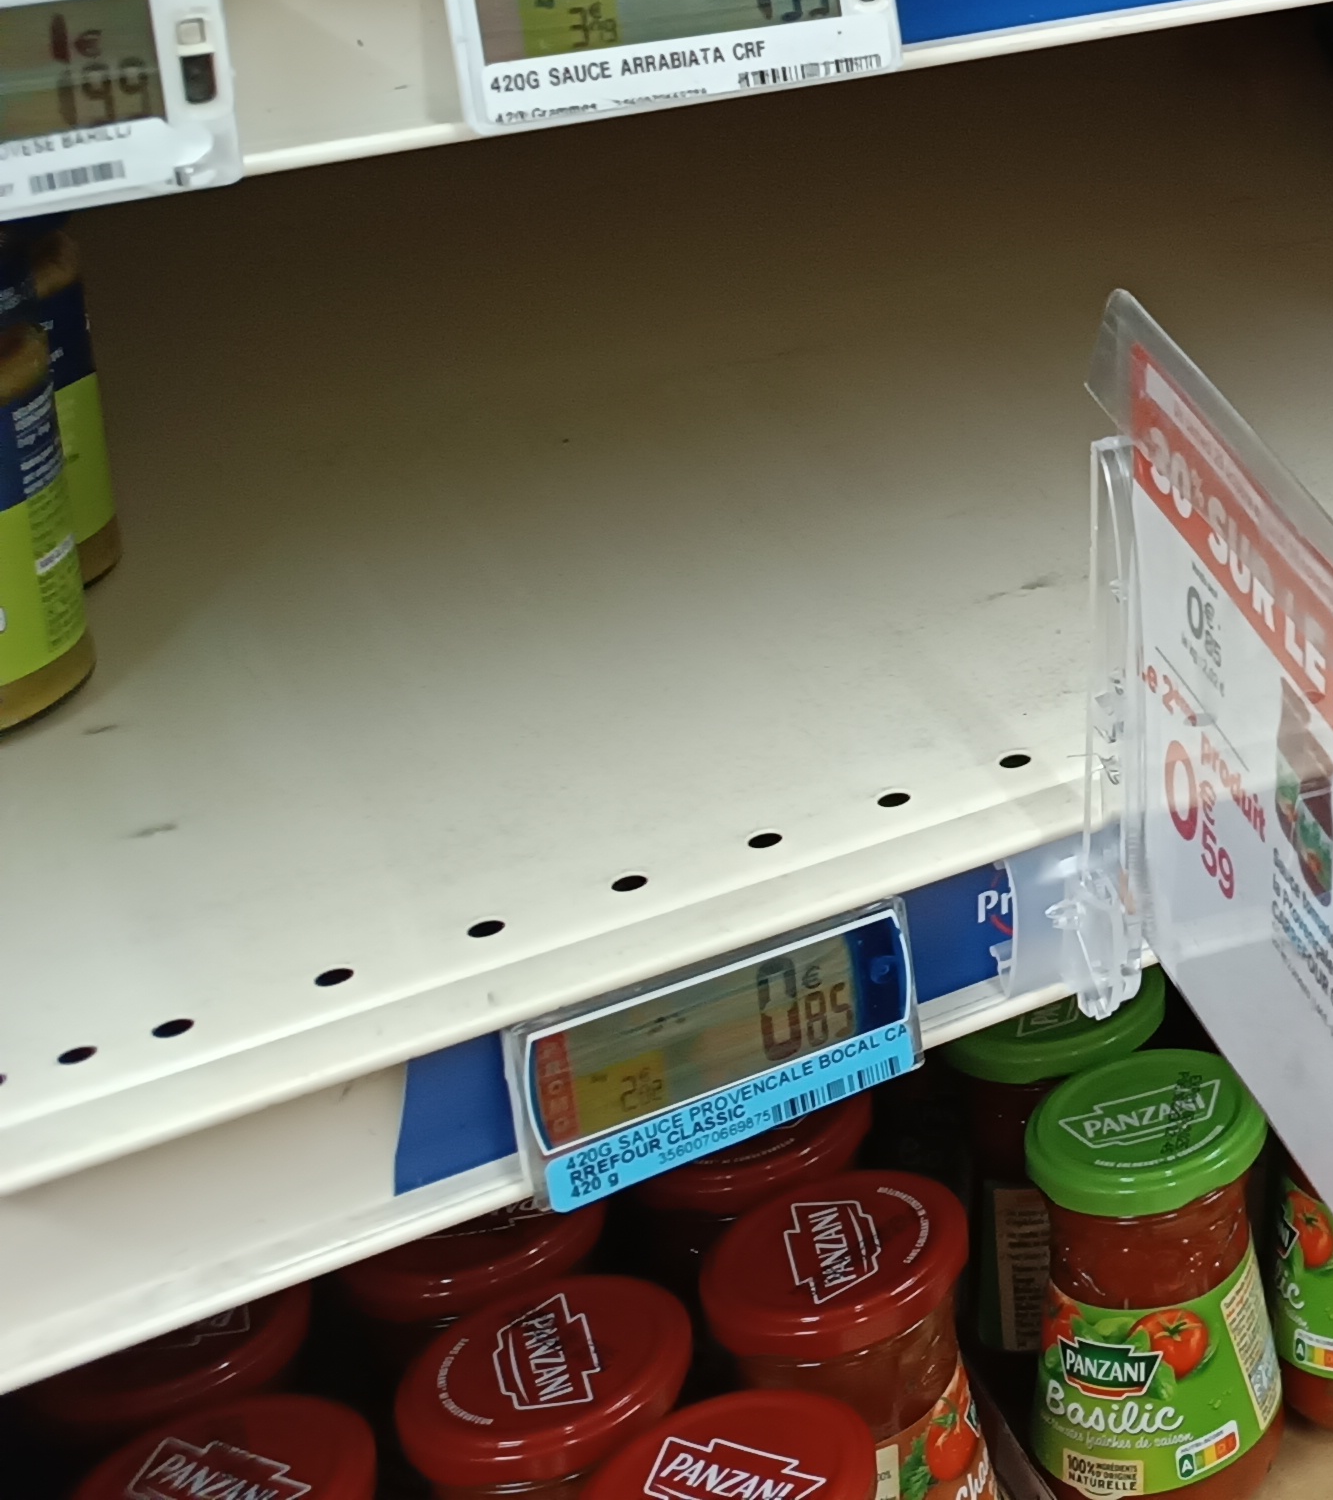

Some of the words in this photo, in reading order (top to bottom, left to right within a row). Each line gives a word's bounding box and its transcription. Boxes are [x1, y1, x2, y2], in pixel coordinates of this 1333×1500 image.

[490, 66, 541, 93] 420G
[549, 59, 612, 88] SAUCE
[620, 46, 726, 77] ARRABIATA
[732, 39, 766, 63] CRF
[566, 1142, 613, 1170] 420G
[618, 1112, 684, 1151] SAUCE
[687, 1059, 815, 1126] PROVENCALE
[819, 1037, 882, 1071] BOCAL
[884, 1023, 909, 1045] CA
[1083, 1090, 1207, 1140] PANZANI
[569, 1138, 663, 1185] RREFOUR
[666, 1107, 747, 1150] CLASSIC
[569, 1177, 603, 1199] 420
[608, 1172, 620, 1189] g
[806, 1207, 858, 1289] PANZANI
[521, 1311, 575, 1403] PANZANI
[1066, 1348, 1147, 1383] PANZANI
[1046, 1379, 1185, 1435] Basilic
[657, 1450, 797, 1500] PANZANI
[1066, 1453, 1096, 1476] 100%
[1067, 1471, 1139, 1492] NATURELLE
